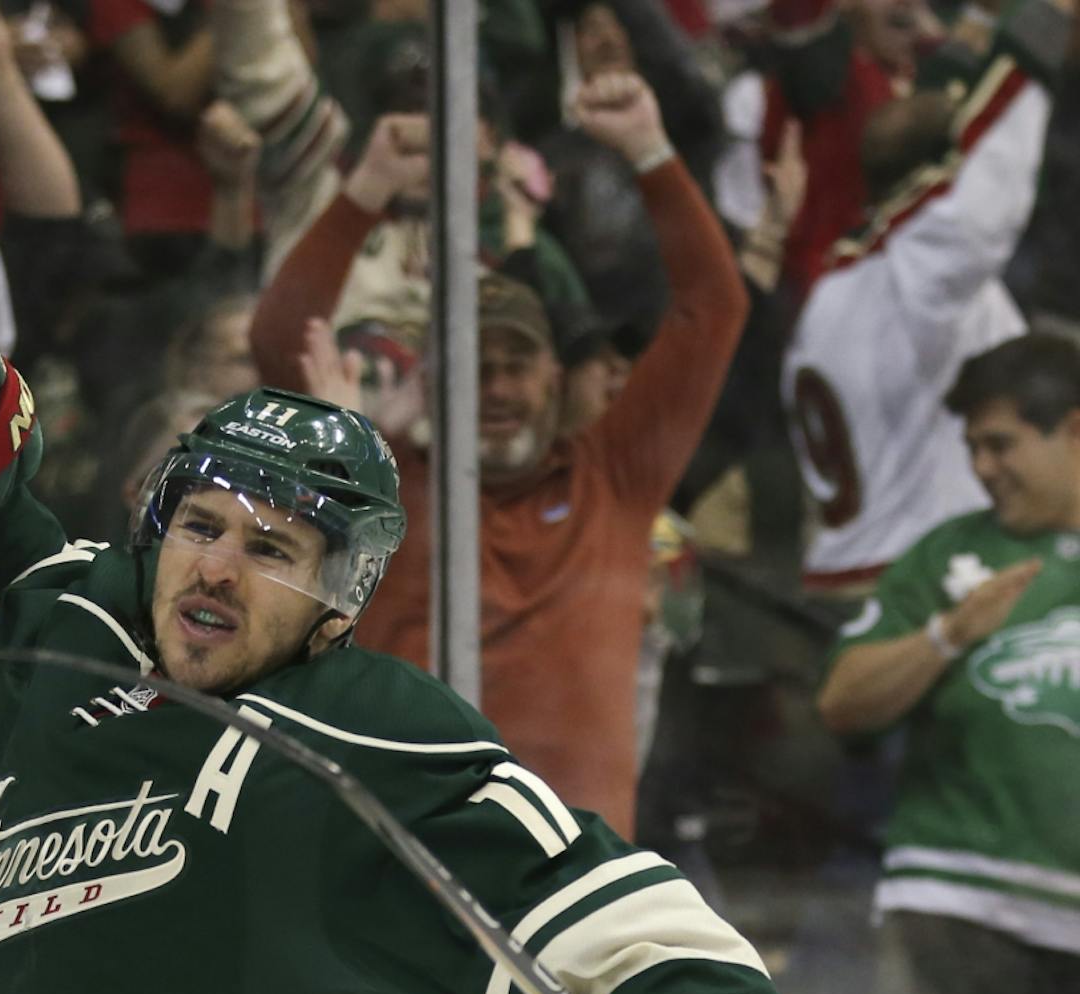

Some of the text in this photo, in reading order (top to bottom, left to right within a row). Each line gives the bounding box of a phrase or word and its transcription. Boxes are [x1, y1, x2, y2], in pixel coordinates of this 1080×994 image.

[223, 421, 297, 450] EASTON
[184, 705, 273, 835] A
[468, 761, 582, 859] 11
